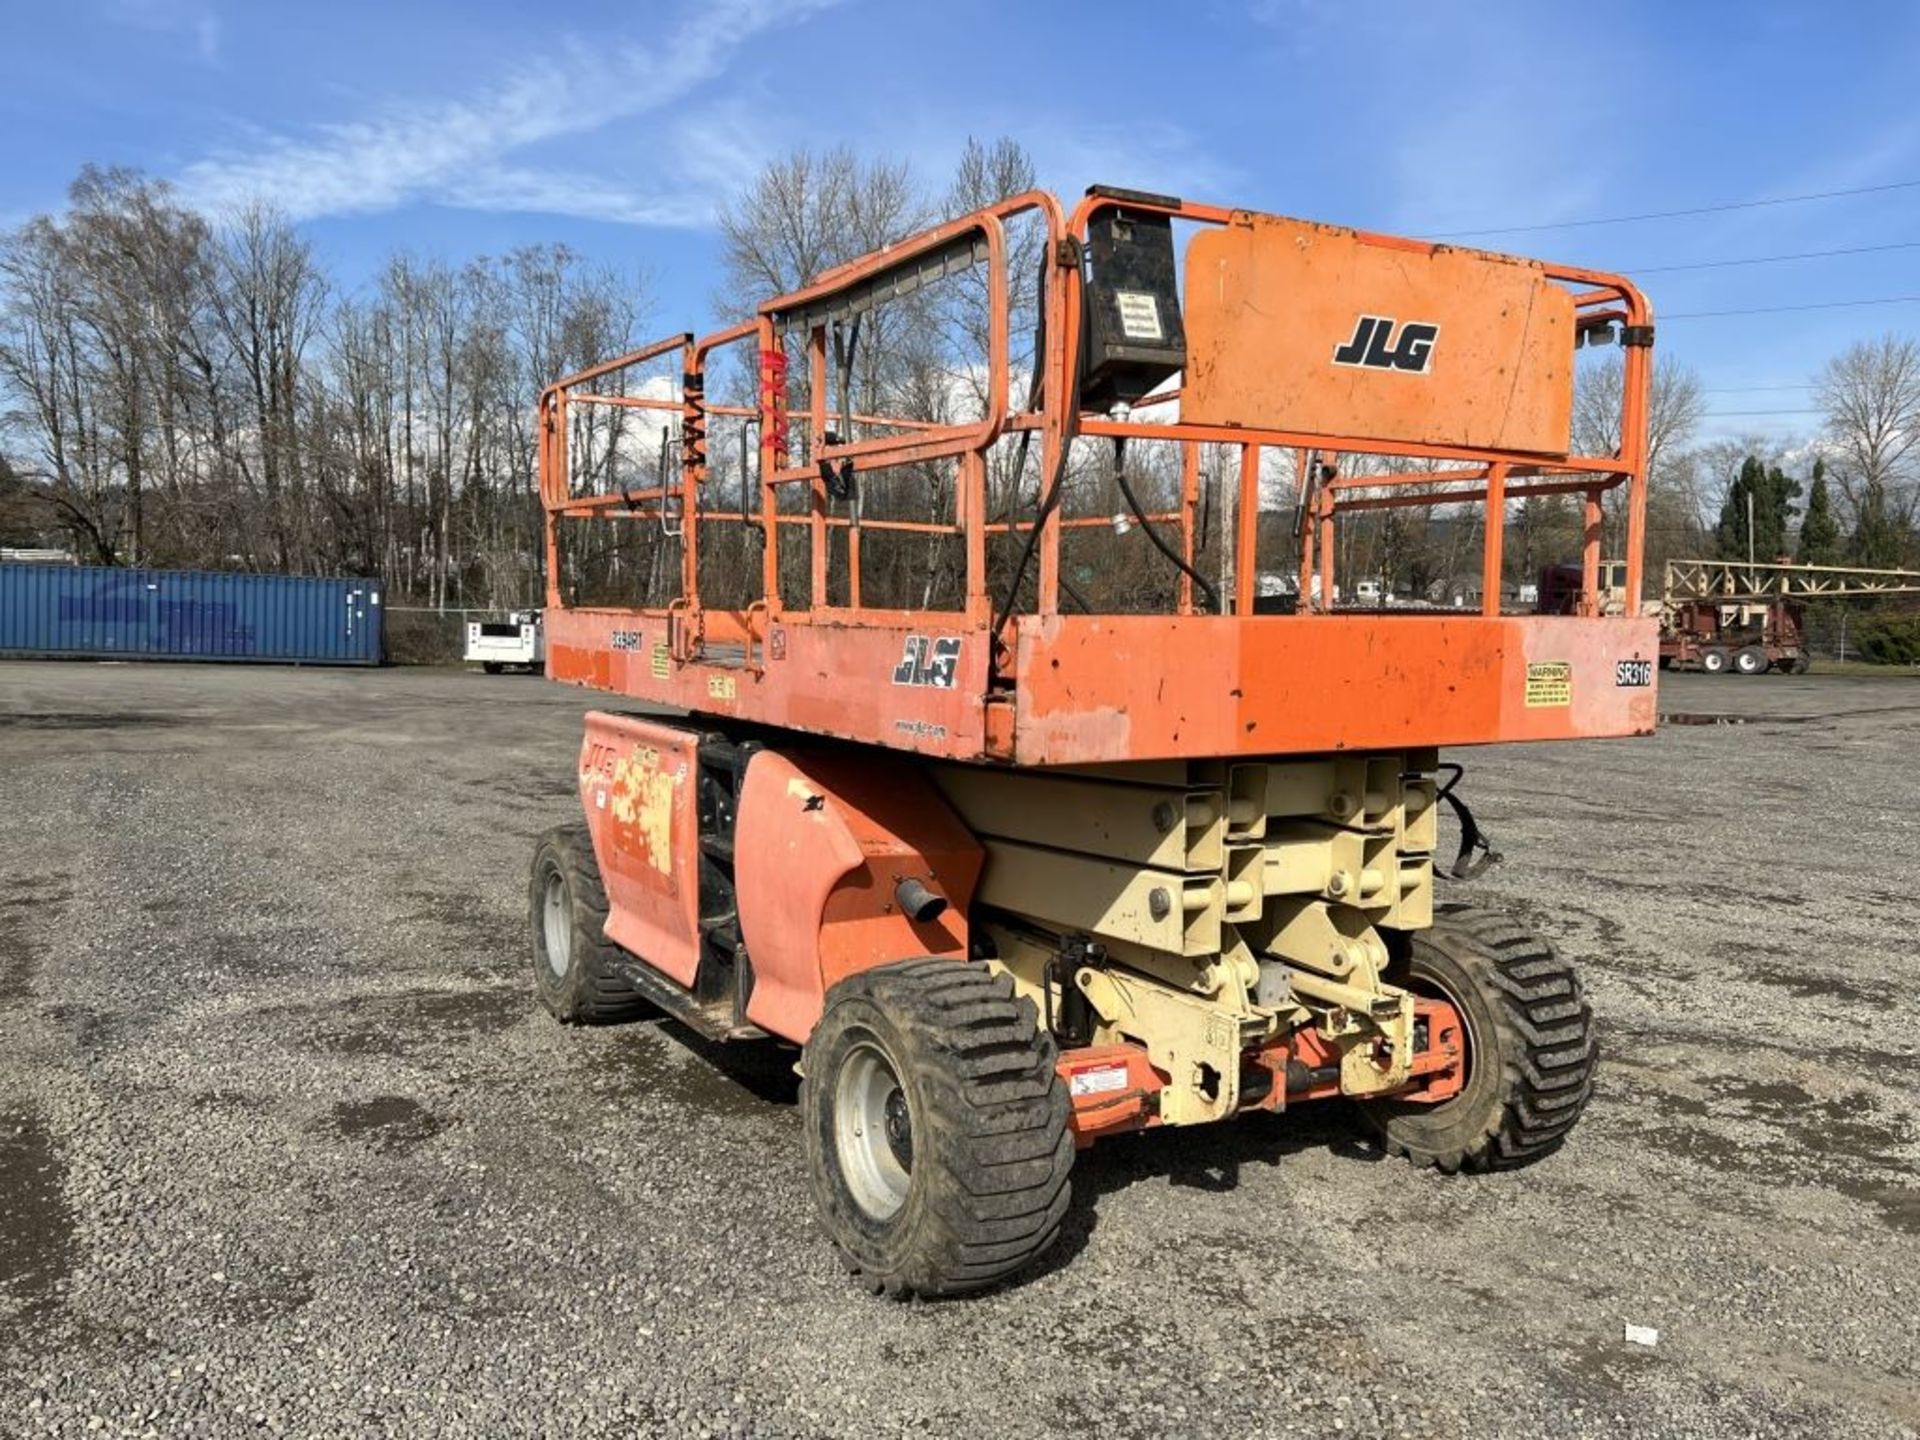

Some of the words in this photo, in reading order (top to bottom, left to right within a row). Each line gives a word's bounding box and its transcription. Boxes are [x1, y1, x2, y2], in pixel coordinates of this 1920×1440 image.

[1333, 316, 1438, 373] JLG
[893, 636, 961, 688] JLG
[1616, 662, 1651, 685] SR316
